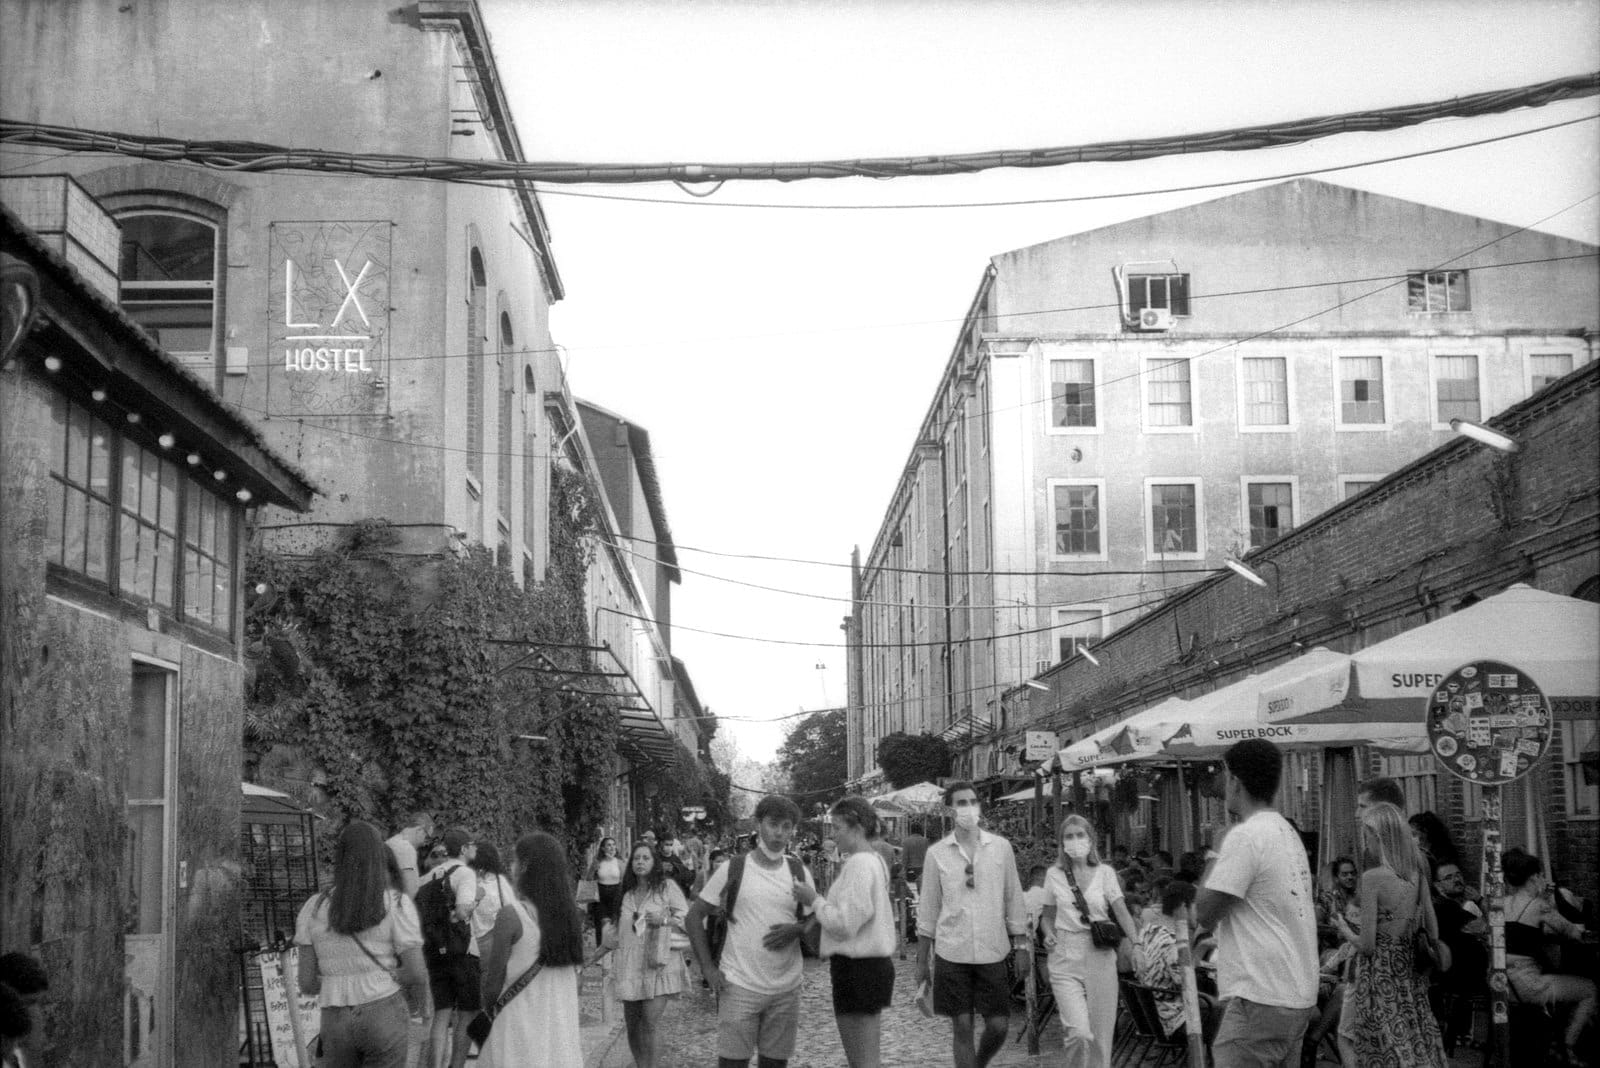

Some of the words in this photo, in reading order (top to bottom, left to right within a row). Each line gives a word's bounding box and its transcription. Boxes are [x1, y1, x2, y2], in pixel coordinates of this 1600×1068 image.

[285, 259, 371, 327] LX
[285, 347, 372, 371] HOSTEL
[1216, 728, 1256, 741] SUPER
[1257, 726, 1293, 738] BOCK
